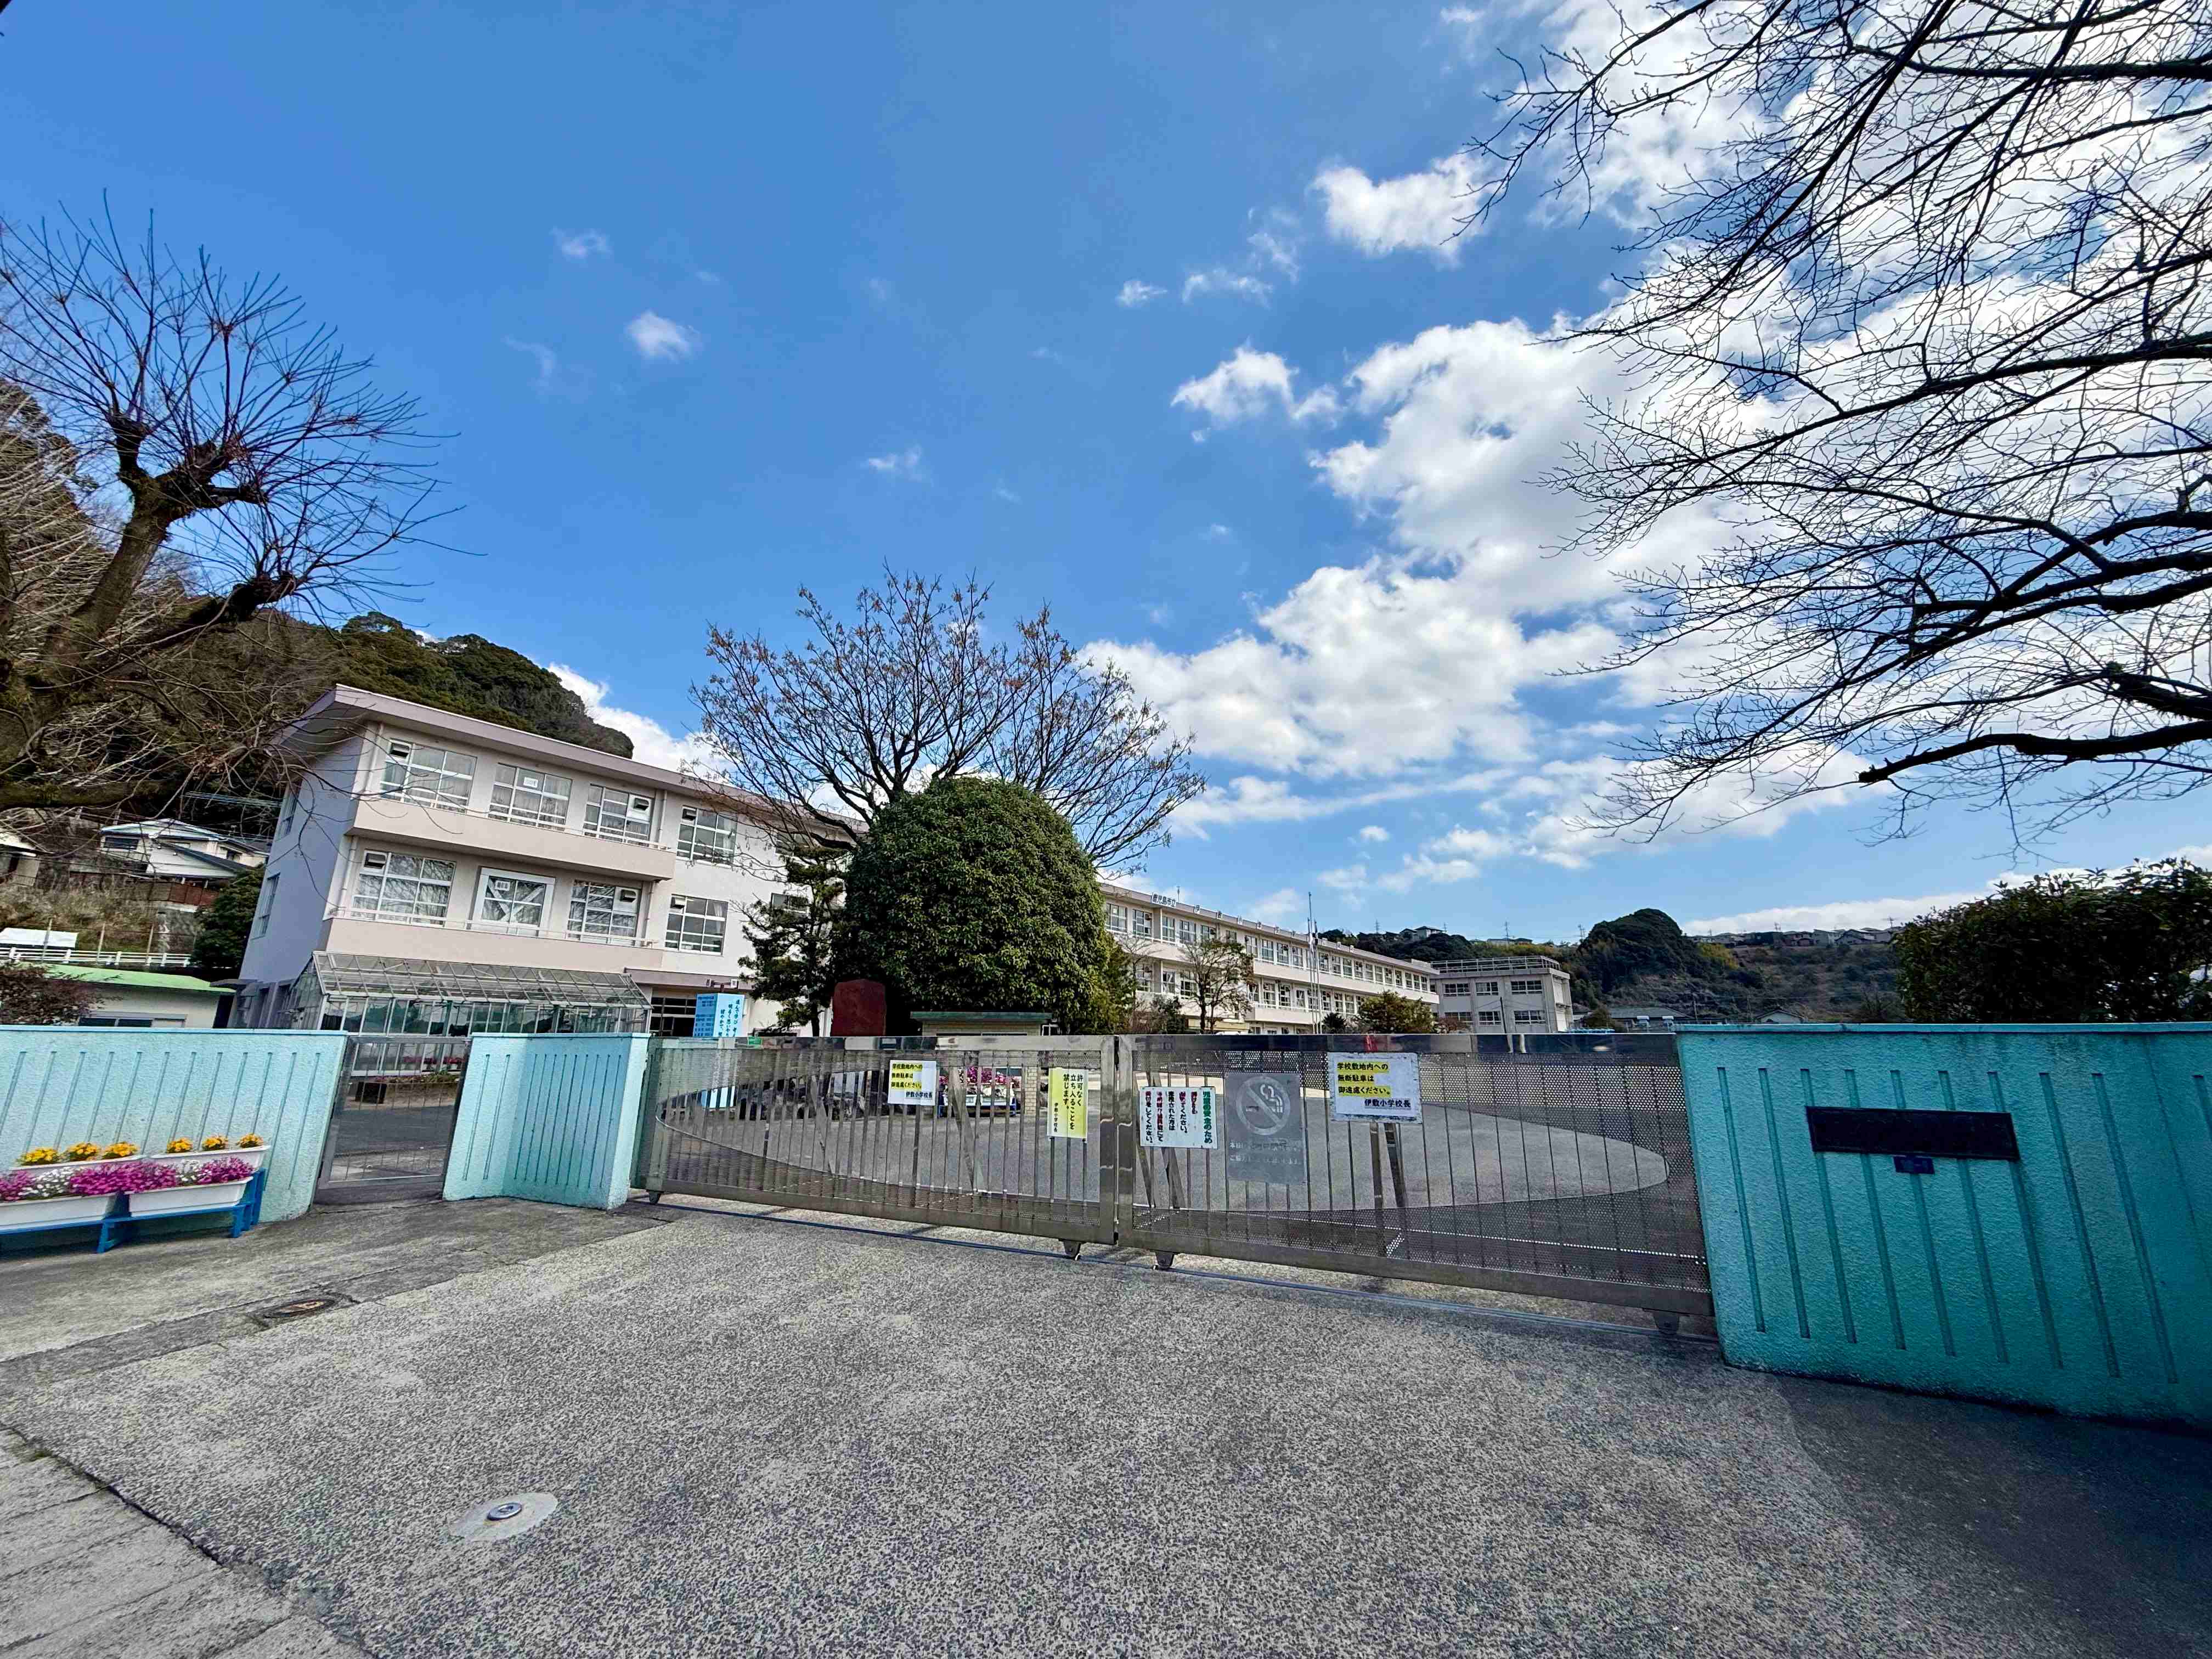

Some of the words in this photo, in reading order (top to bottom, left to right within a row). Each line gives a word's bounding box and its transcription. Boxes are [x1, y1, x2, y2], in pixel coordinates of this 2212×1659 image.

[1337, 1062, 1389, 1070] 学校敷地内への
[1338, 1074, 1374, 1082] 無断駐車は
[1338, 1086, 1391, 1095] 御遠慮ください。
[1364, 1099, 1412, 1108] 伊敷小学校長
